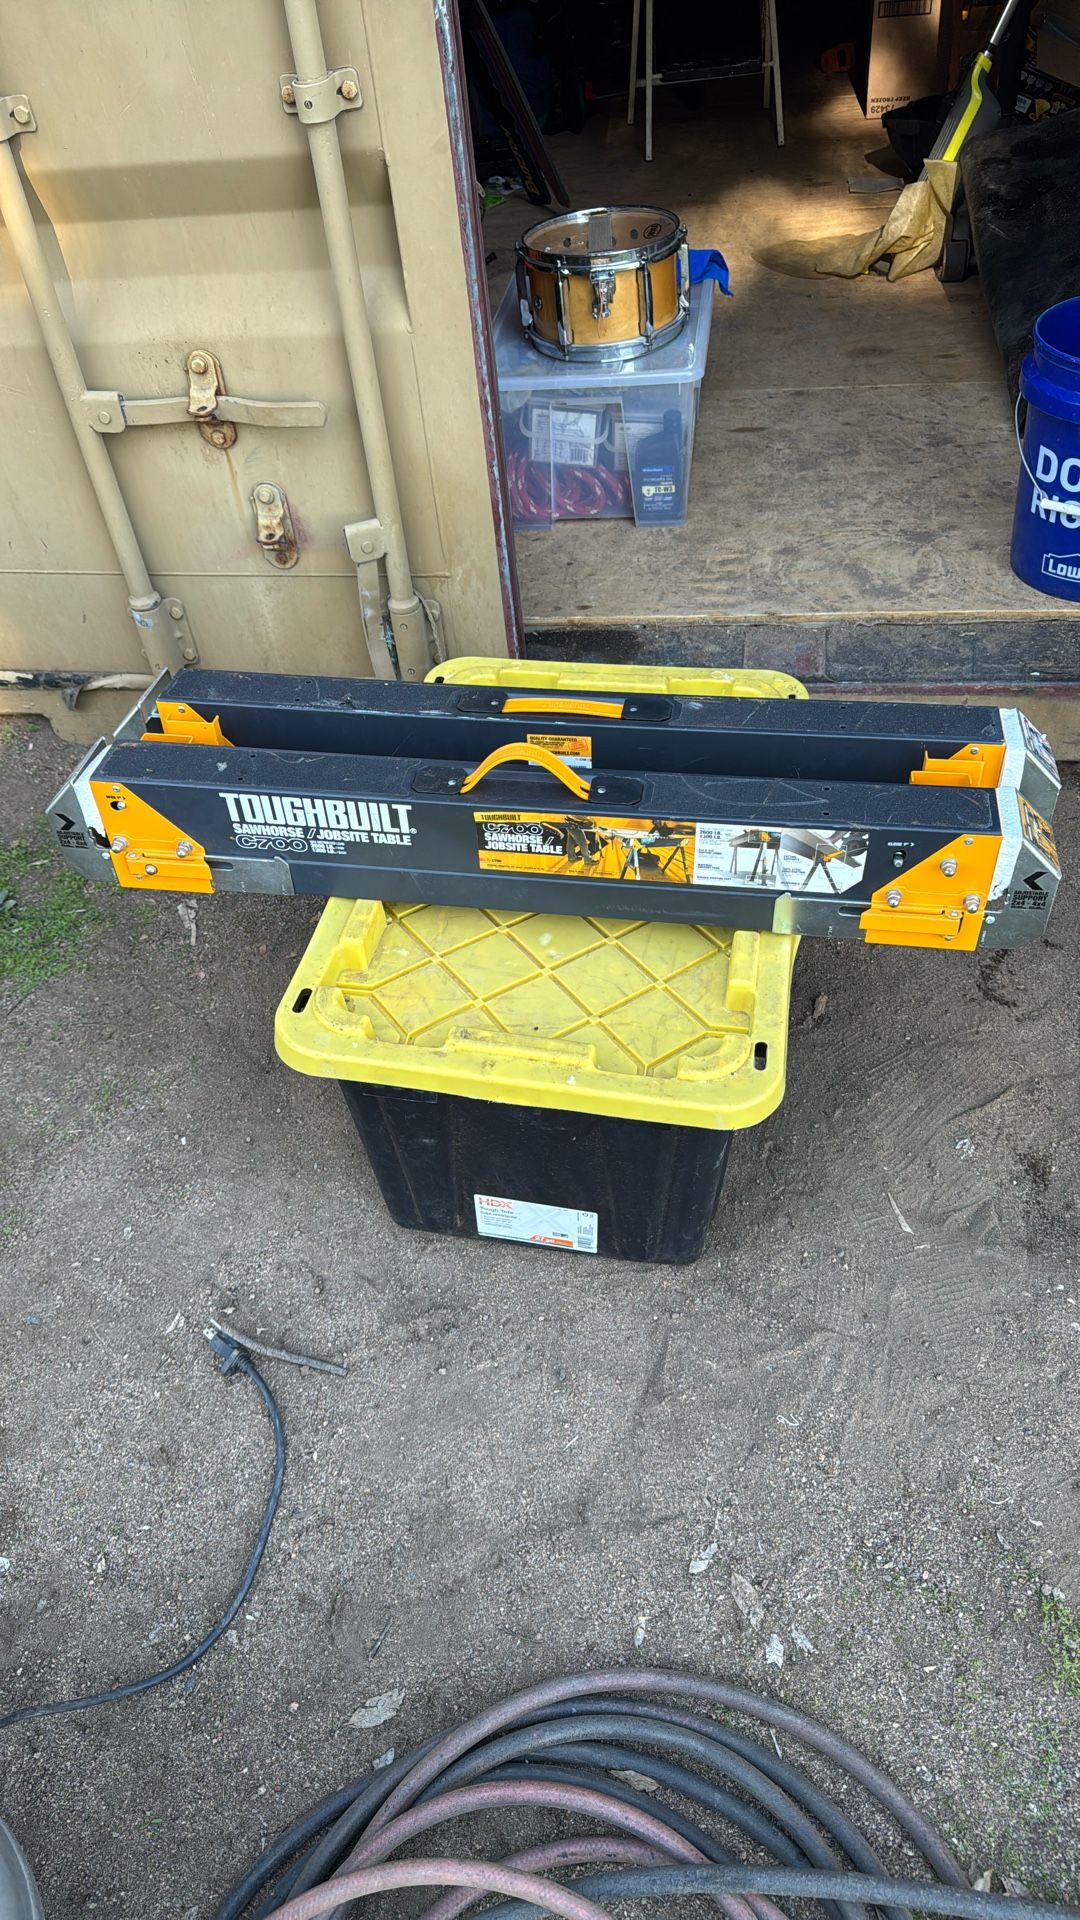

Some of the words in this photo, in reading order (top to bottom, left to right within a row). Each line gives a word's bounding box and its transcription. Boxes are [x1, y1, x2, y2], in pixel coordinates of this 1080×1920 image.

[1036, 444, 1080, 493] DO
[232, 823, 305, 839] SAWHORSE
[316, 828, 370, 843] JOBSITE
[370, 832, 412, 846] TABLE
[482, 823, 544, 836] C700
[235, 834, 309, 852] C700
[484, 832, 543, 845] SAWHORSE
[485, 841, 528, 852] JOBSITE
[529, 844, 563, 855] TABLE
[1012, 894, 1048, 902] SUPPORT
[479, 1197, 513, 1209] HDX
